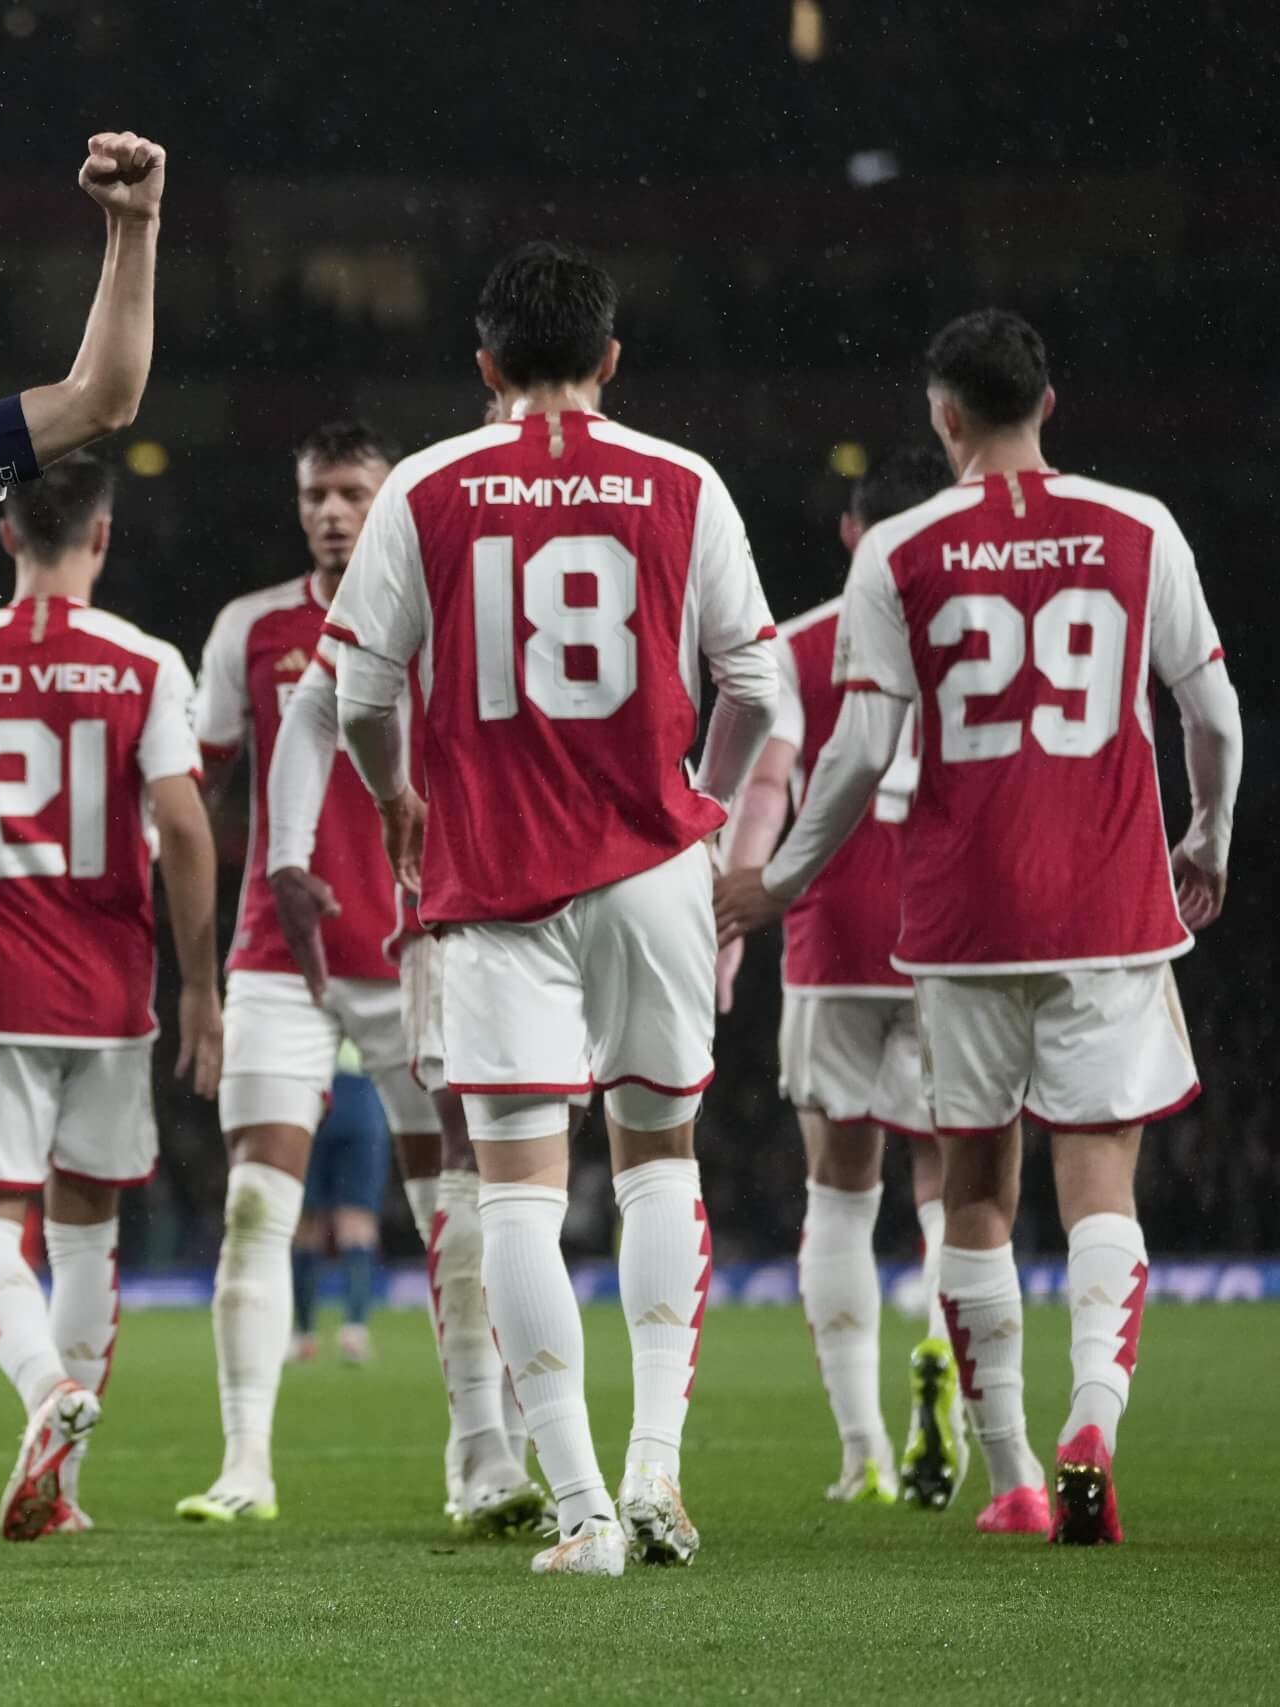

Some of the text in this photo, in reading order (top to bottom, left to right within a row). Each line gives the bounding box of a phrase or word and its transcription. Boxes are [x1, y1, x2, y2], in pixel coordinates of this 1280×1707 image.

[460, 475, 652, 507] TOMIYASU
[942, 536, 1105, 571] HAVERTZ
[473, 535, 637, 721] 18
[29, 663, 143, 695] VIEIRA
[928, 588, 1128, 763] 29
